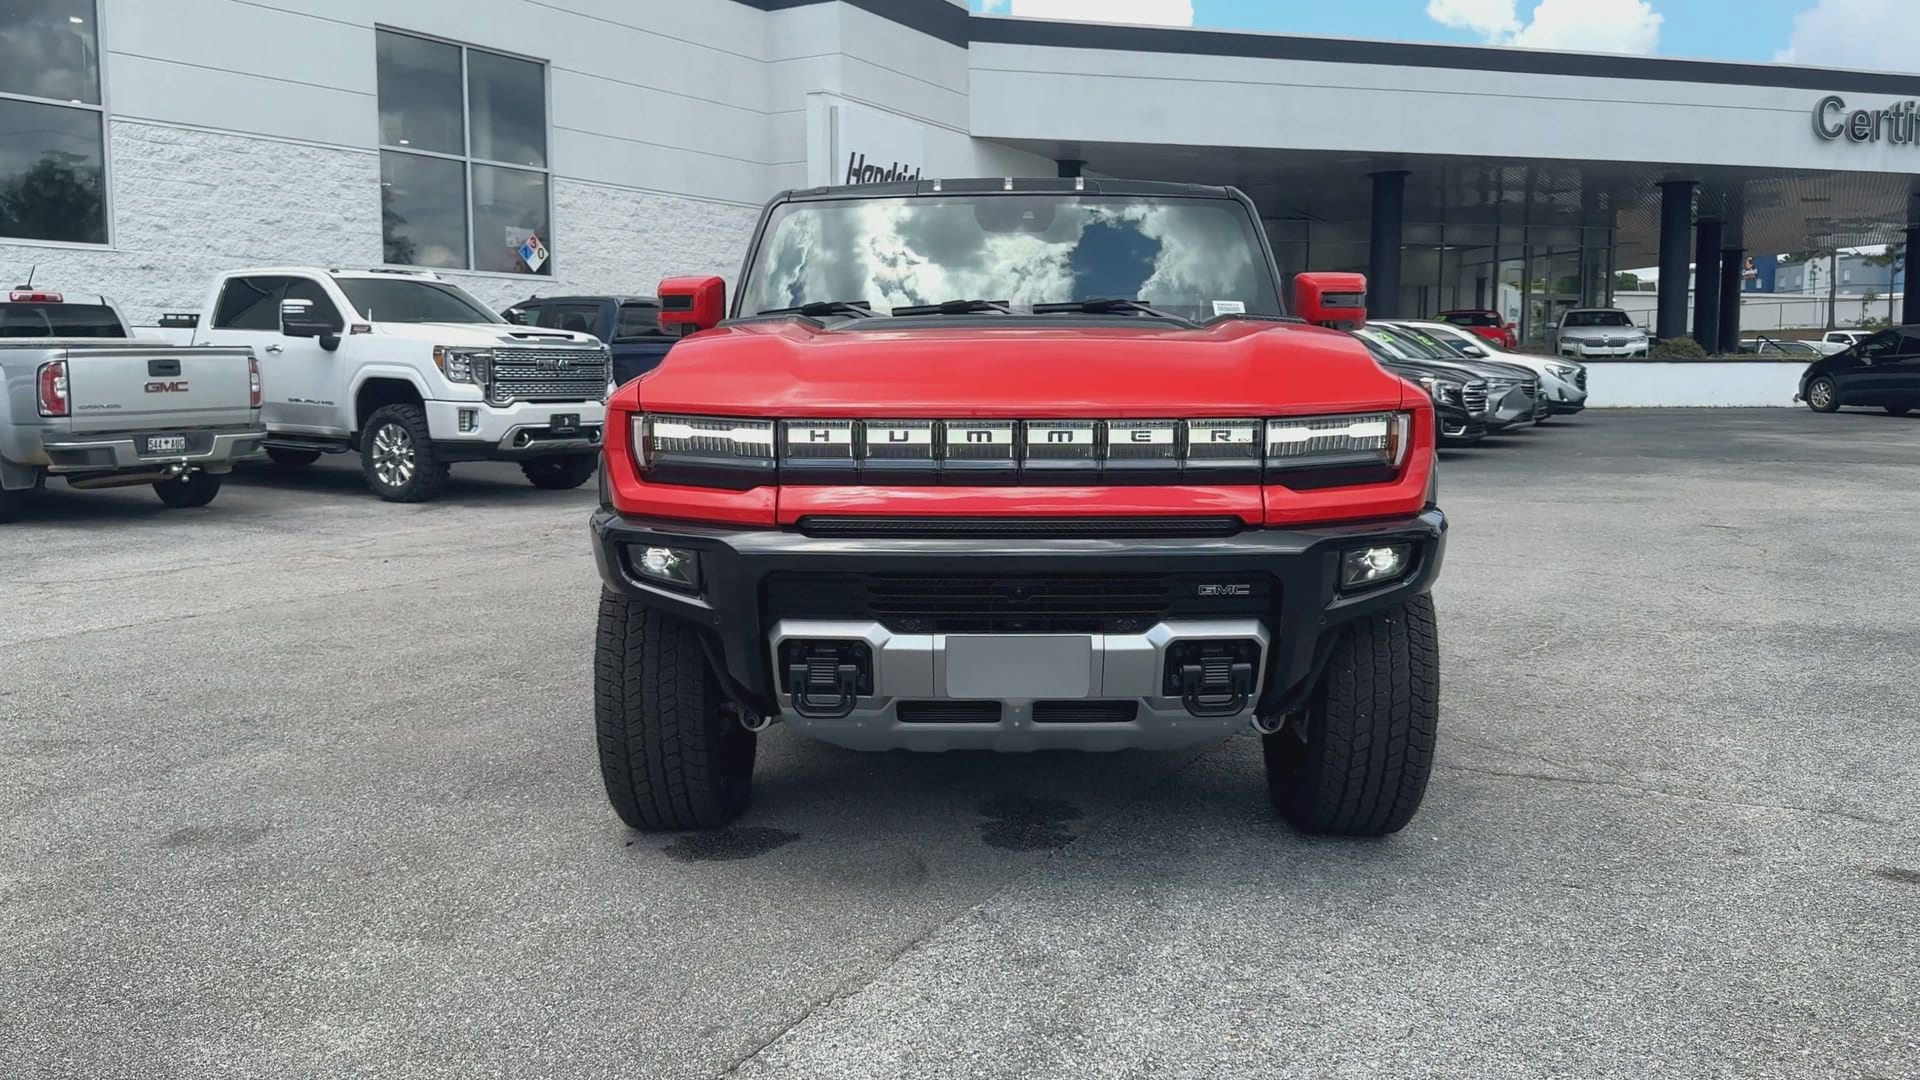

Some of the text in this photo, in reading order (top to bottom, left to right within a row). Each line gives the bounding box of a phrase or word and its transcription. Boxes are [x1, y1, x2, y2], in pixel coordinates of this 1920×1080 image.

[846, 151, 922, 185] Hendri
[530, 236, 537, 249] 3
[538, 248, 545, 259] 0
[144, 382, 189, 393] GMC
[1198, 584, 1250, 595] GMC
